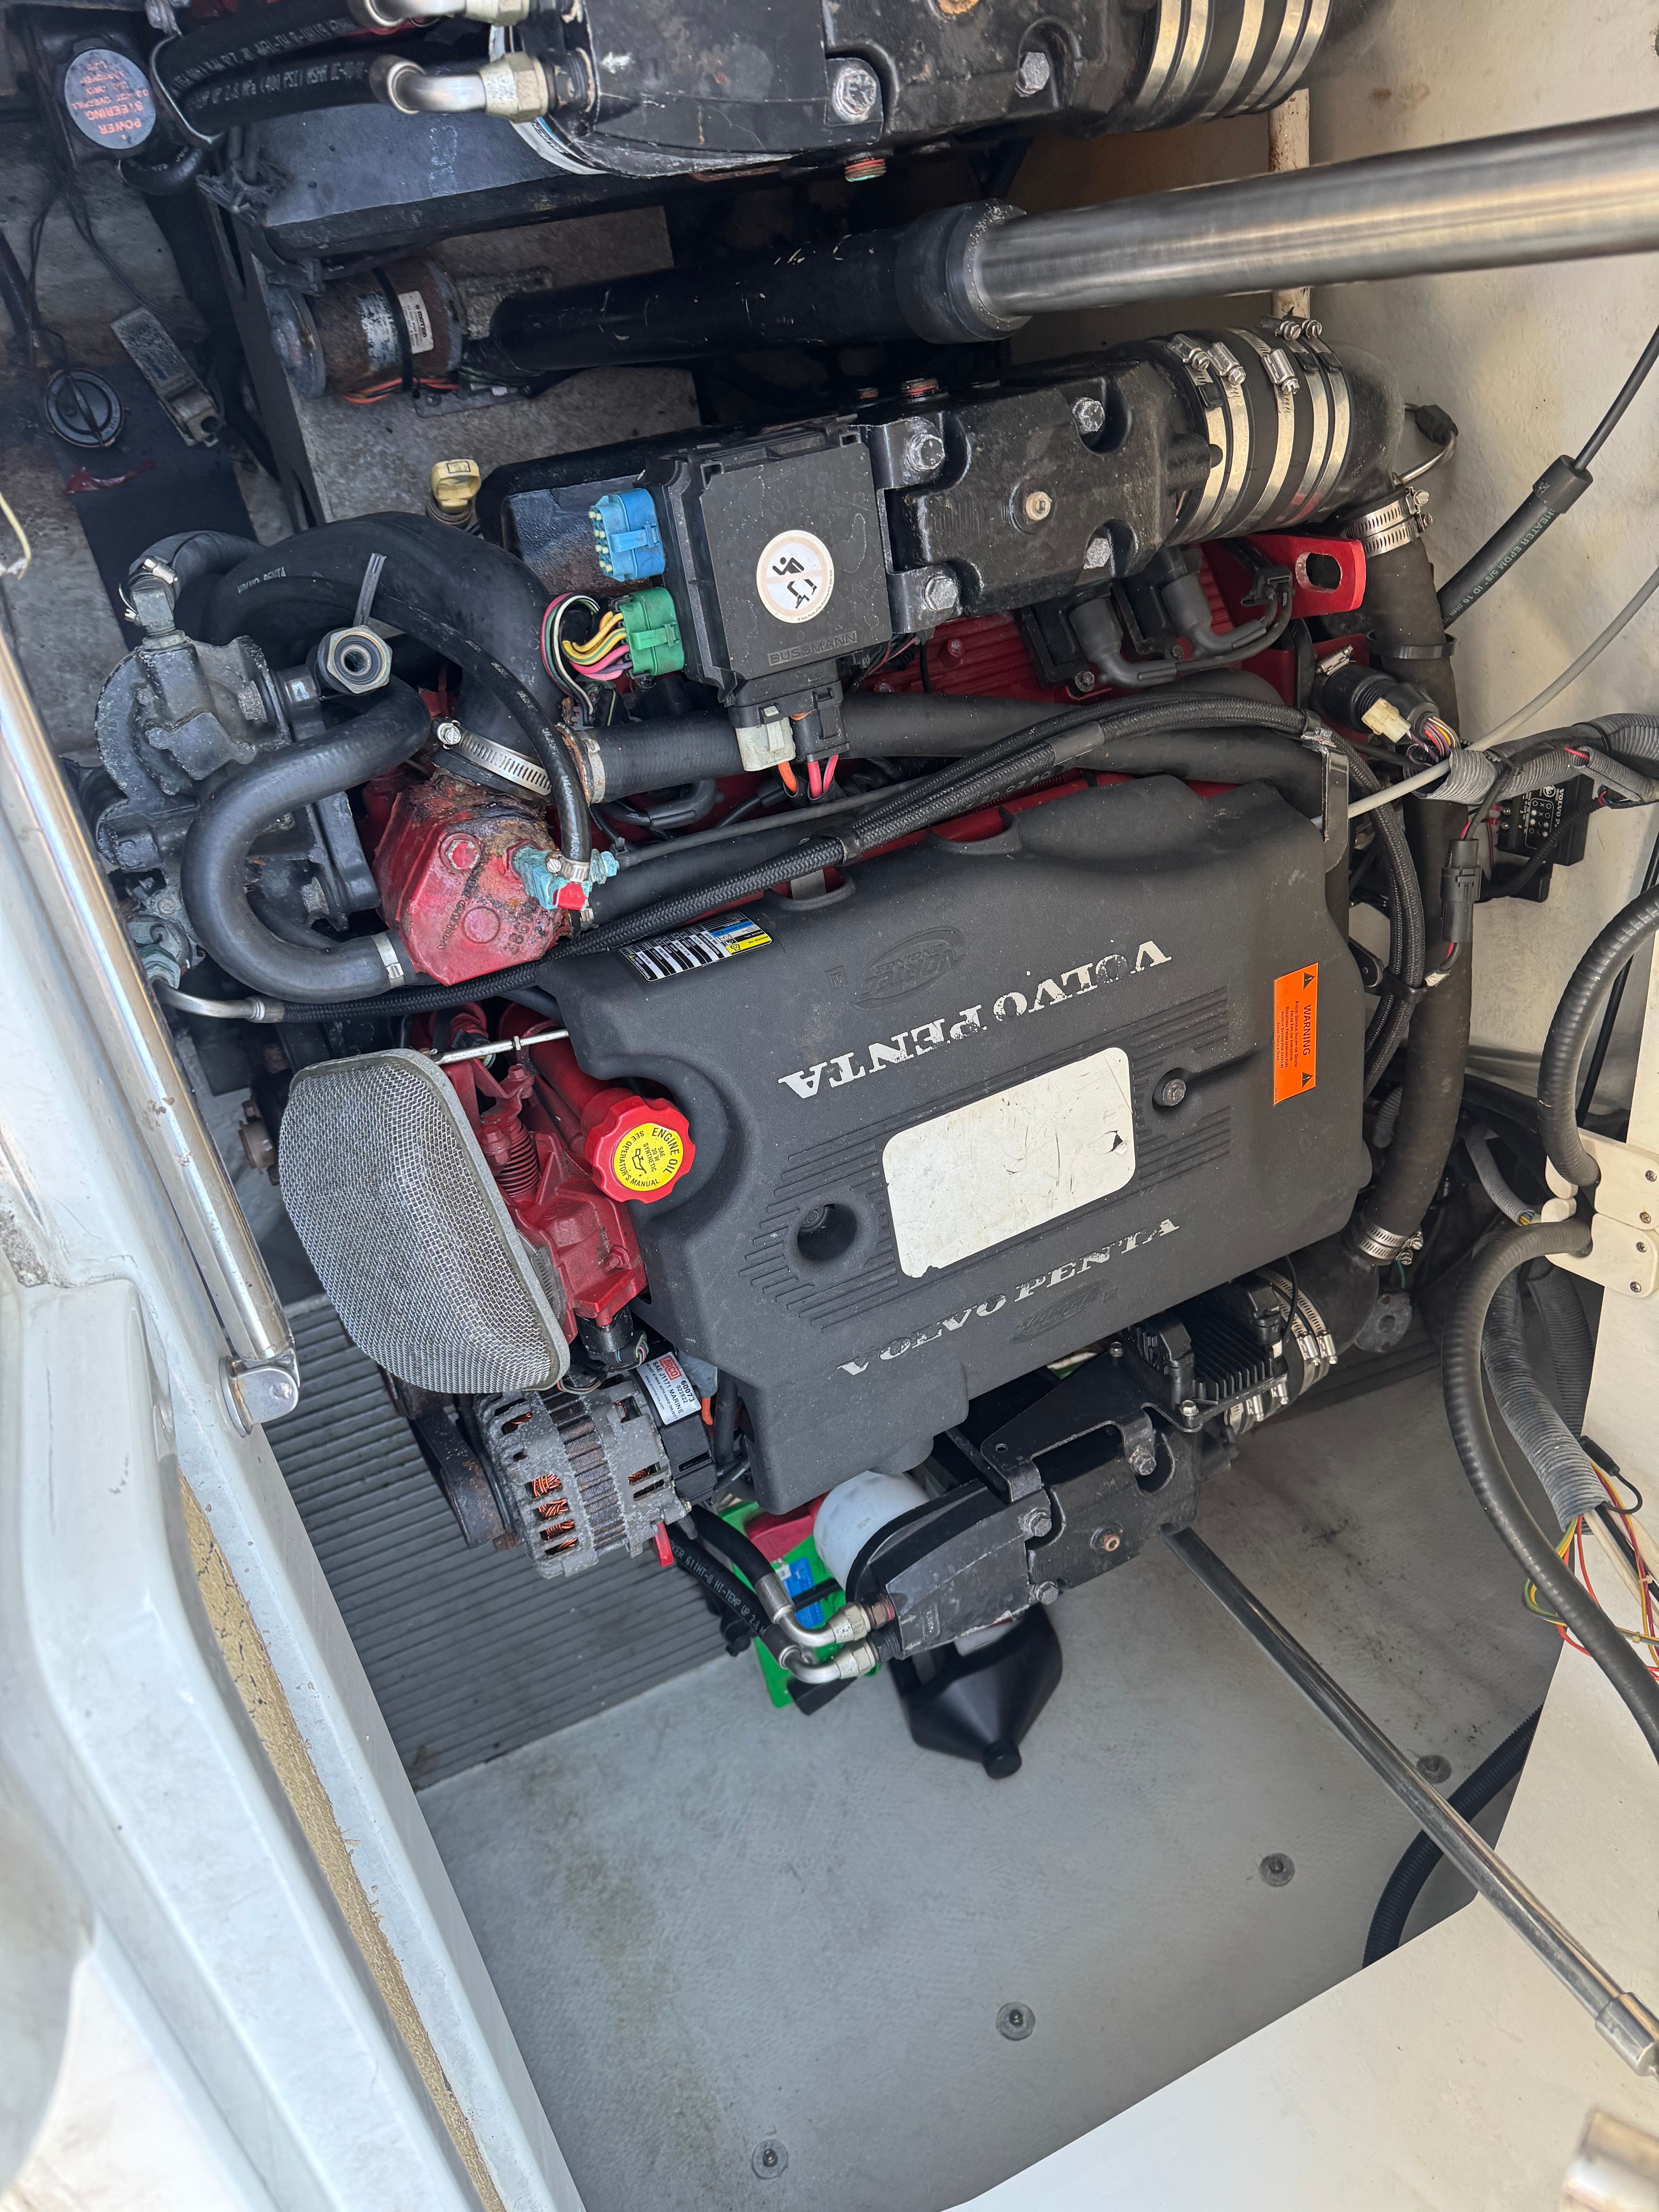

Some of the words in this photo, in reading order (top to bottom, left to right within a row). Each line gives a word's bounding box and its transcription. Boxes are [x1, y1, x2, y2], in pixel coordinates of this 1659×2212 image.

[85, 101, 144, 121] STEERING
[98, 118, 142, 134] POWER
[1498, 546, 1522, 570] EPDM
[770, 632, 856, 663] BUSSMANN
[1556, 788, 1565, 817] VOLVO
[994, 940, 1172, 1022] VOLVO
[1303, 1004, 1311, 1056] WARNING
[778, 1005, 987, 1099] PENTA
[631, 1130, 644, 1142] SEE
[652, 1127, 679, 1156] ENGINE
[619, 1141, 632, 1181] OPERATOR'S
[643, 1142, 657, 1172] SYNTHETIC
[663, 1159, 678, 1174] OIL
[630, 1178, 659, 1187] MANUAL
[836, 1294, 1007, 1375] VOLVO
[1014, 1218, 1180, 1303] PENTA
[662, 1358, 678, 1377] ARCO
[653, 1361, 663, 1373] SAE
[659, 1372, 672, 1388] J1171
[668, 1388, 684, 1414] MARINE
[676, 1385, 688, 1404] 022822
[681, 1380, 695, 1402] 60073
[669, 1405, 678, 1419] OBJECT
[685, 1556, 714, 1584] 611HT-8
[714, 1580, 742, 1607] HI-TEMP
